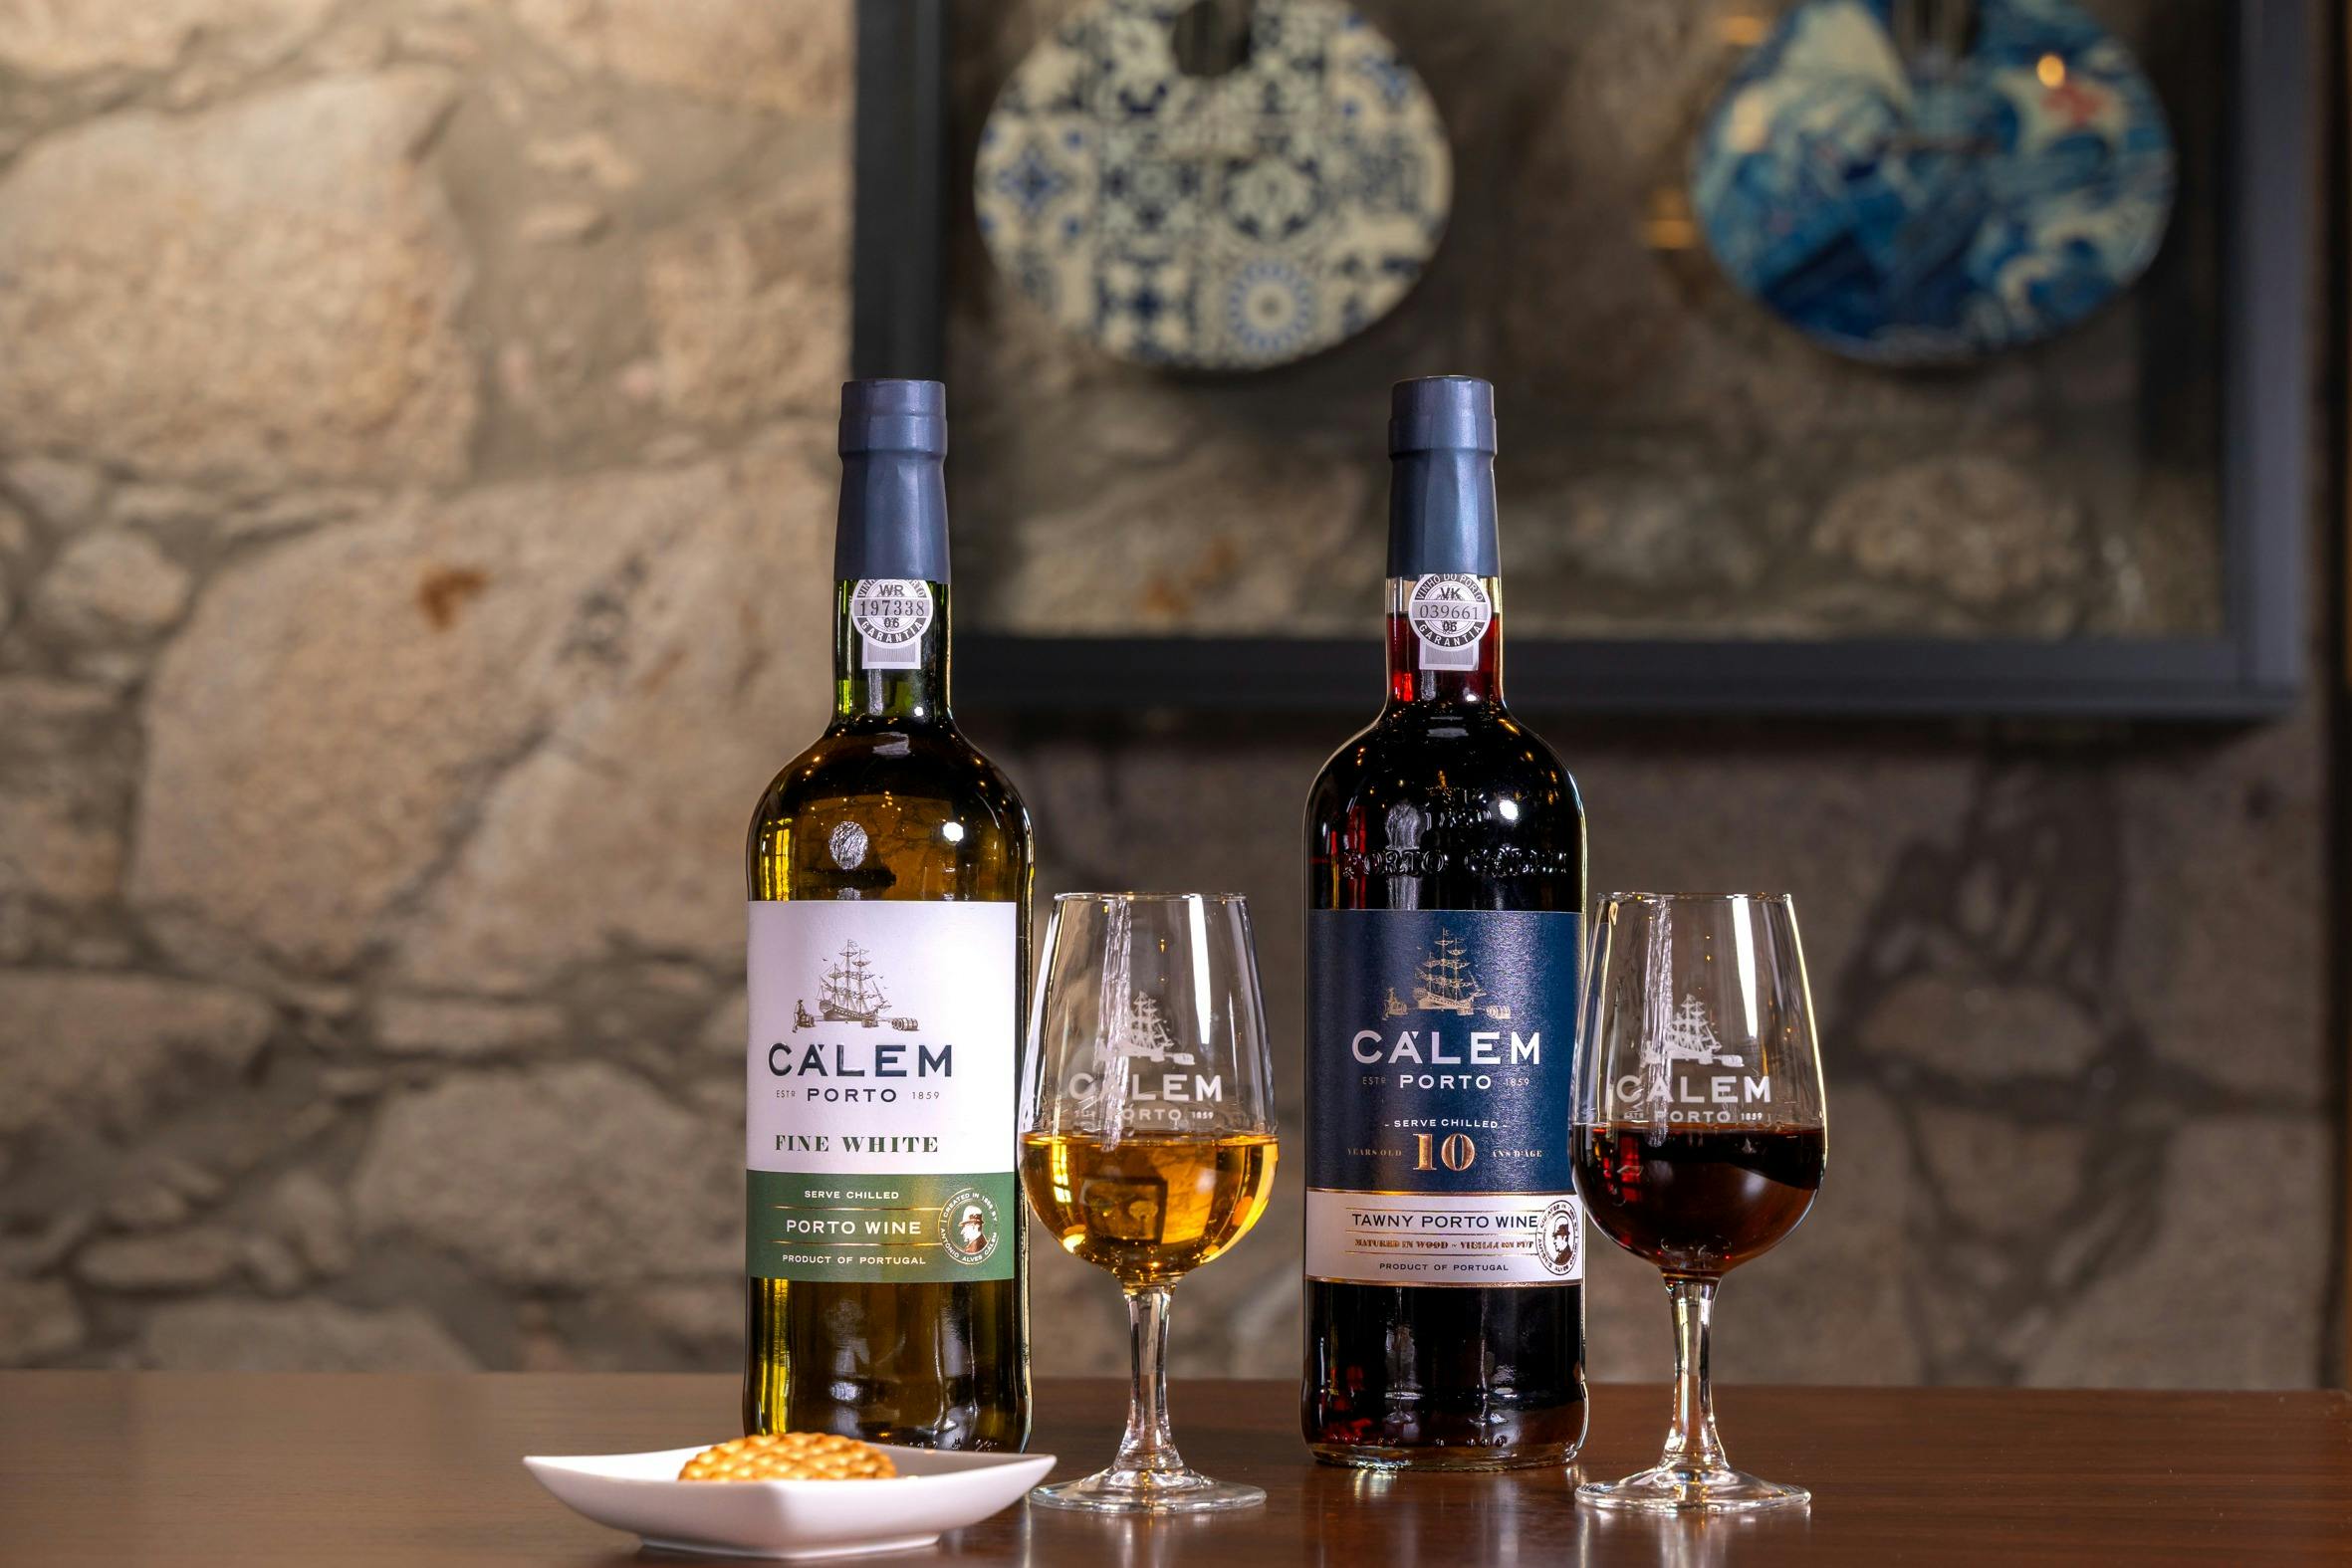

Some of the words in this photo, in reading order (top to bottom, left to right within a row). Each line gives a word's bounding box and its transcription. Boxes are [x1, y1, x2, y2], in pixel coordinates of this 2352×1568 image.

[879, 584, 904, 596] WR
[1415, 574, 1441, 600] VINHO
[1460, 574, 1484, 602] PORTO
[1440, 587, 1461, 600] VK
[860, 599, 925, 616] 197338
[1419, 604, 1479, 620] 039661
[883, 617, 900, 628] 06
[1442, 621, 1458, 632] 06
[861, 621, 923, 644] GARANTIA
[1419, 624, 1482, 647] GARANTIA
[1351, 1030, 1539, 1065] CÁLEM
[768, 1042, 952, 1077] CÁLEM
[1399, 1074, 1492, 1089] PORTO
[807, 1088, 897, 1102] PORTO
[912, 1091, 940, 1100] 1859
[1394, 1119, 1437, 1128] SERVE
[1441, 1118, 1499, 1129] CHILLED
[1741, 1112, 1763, 1121] 1859
[775, 1134, 829, 1152] FINE
[842, 1136, 938, 1153] WHITE
[1412, 1132, 1476, 1171] 10
[804, 1190, 840, 1200] SERVE
[845, 1191, 899, 1200] CHILLED
[943, 1193, 970, 1219] CREATED
[786, 1220, 856, 1234] PORTO
[864, 1221, 922, 1234] WINE
[1352, 1214, 1417, 1228] TAWNY
[1421, 1216, 1489, 1229] PORTO
[1496, 1215, 1537, 1229] WINE
[1416, 1240, 1449, 1249] WOOD
[782, 1254, 831, 1264] PRODUCT
[837, 1255, 853, 1264] OF
[859, 1256, 926, 1265] PORTUGAL
